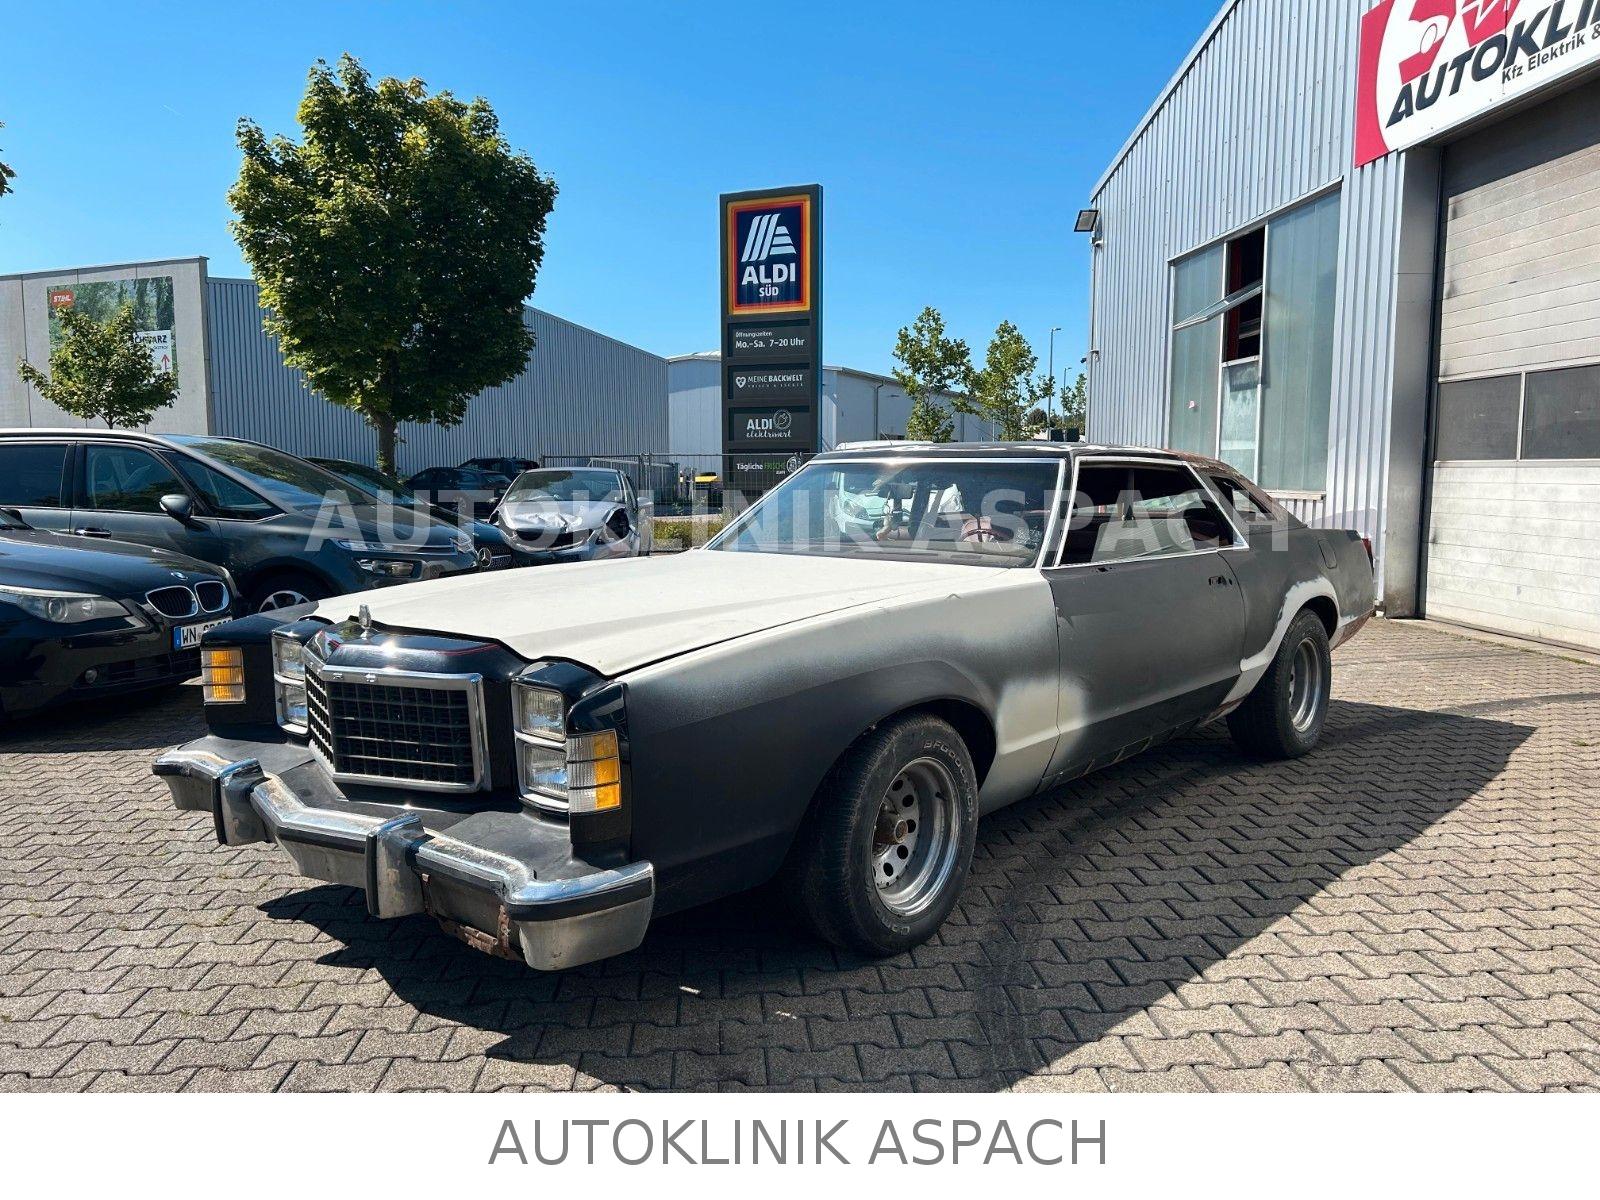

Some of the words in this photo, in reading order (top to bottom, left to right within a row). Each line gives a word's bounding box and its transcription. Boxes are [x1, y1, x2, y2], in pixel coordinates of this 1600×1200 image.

[1386, 0, 1600, 128] AUTOKLI
[1502, 65, 1523, 84] Kfz
[1528, 33, 1585, 71] Elektrik
[741, 262, 796, 285] ALDI
[759, 284, 779, 297] SÜD
[790, 337, 805, 346] Uhr
[747, 375, 768, 383] MEINE
[768, 374, 803, 382] BACKWELT
[746, 418, 773, 430] ALDI
[736, 462, 764, 472] Tägliche
[182, 626, 197, 645] WN
